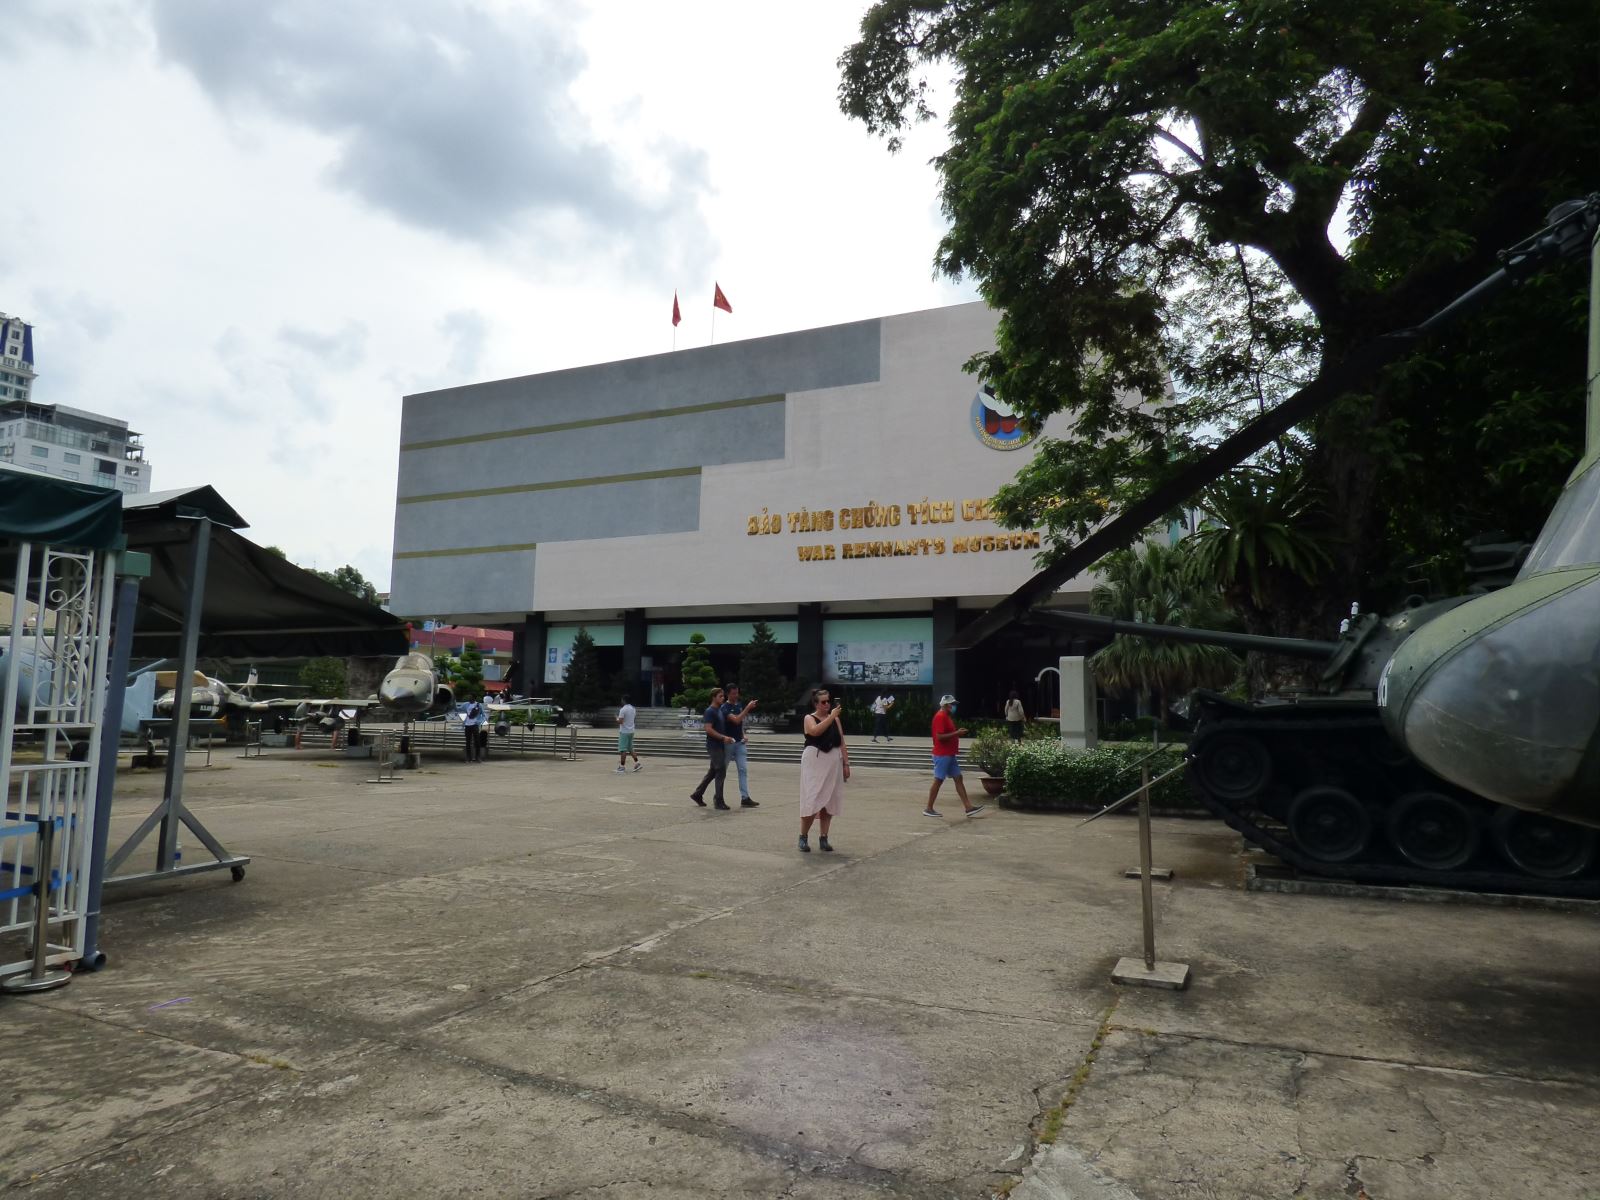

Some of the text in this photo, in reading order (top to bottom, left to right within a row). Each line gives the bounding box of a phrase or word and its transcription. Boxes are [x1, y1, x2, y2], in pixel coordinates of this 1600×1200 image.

[798, 531, 1041, 561] WAR REMNANTS MUSEUM
